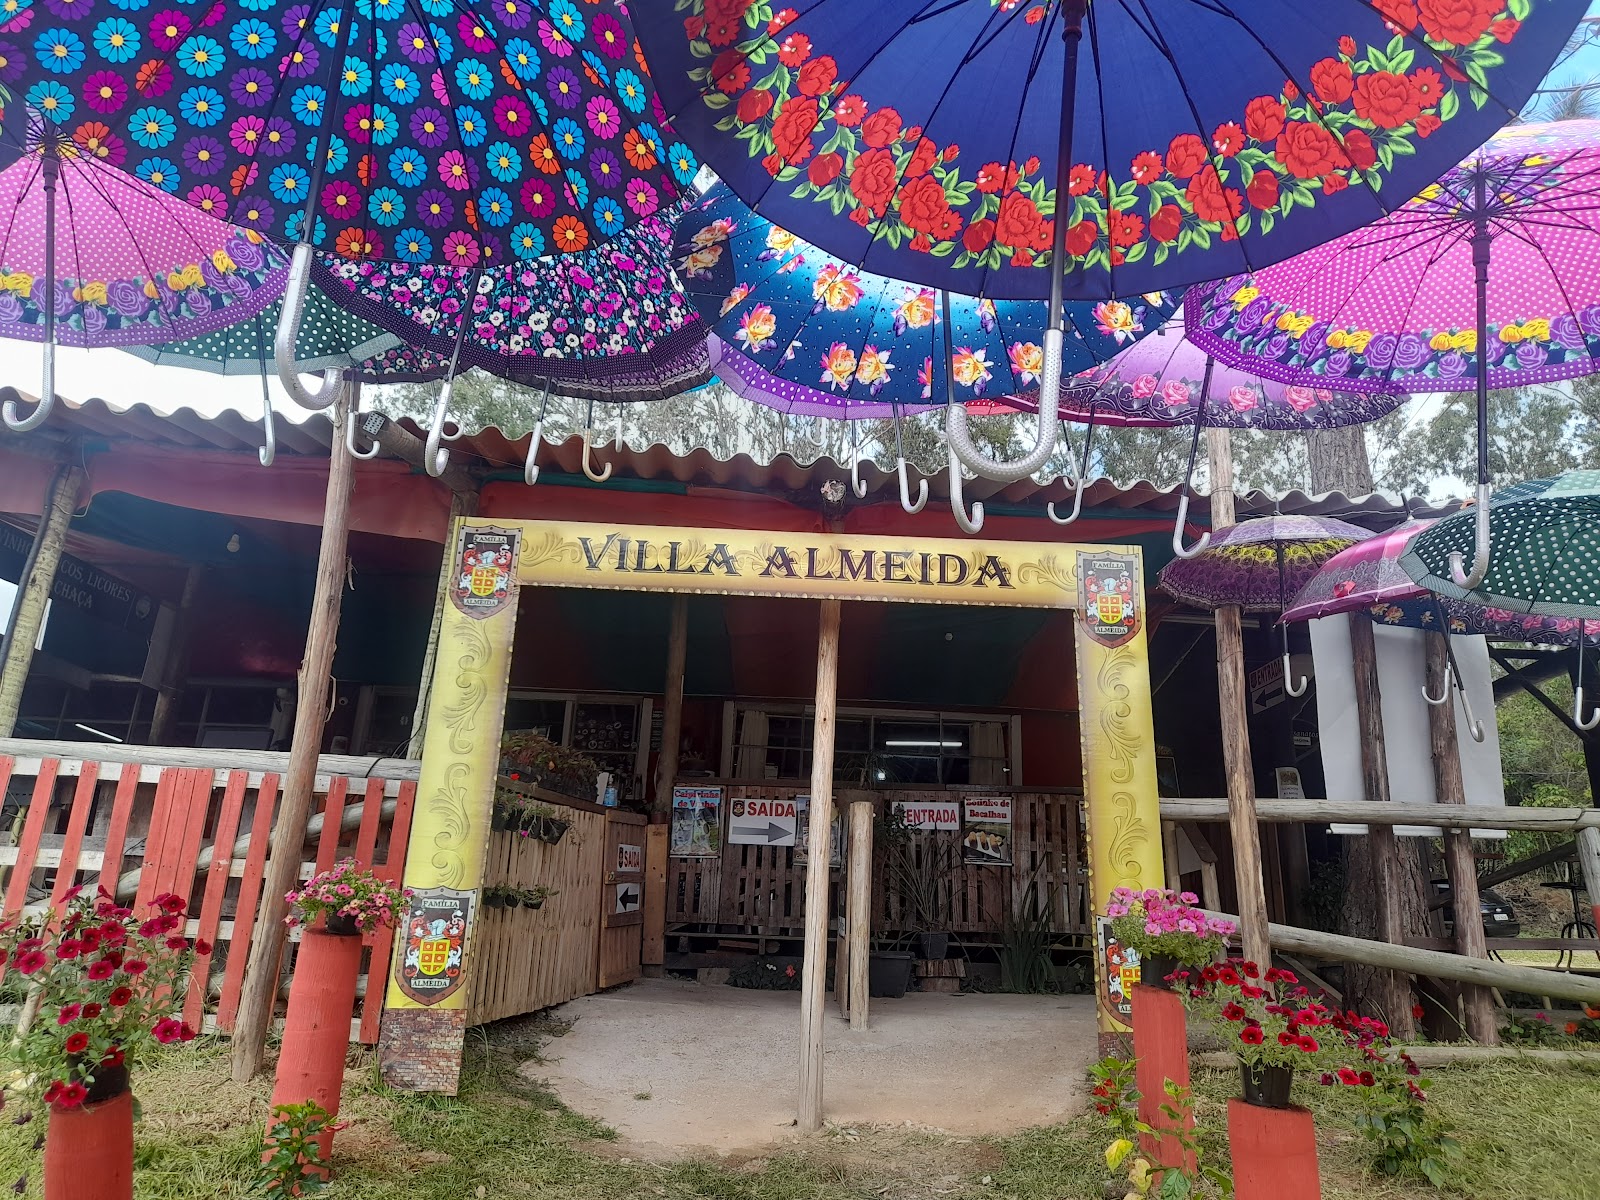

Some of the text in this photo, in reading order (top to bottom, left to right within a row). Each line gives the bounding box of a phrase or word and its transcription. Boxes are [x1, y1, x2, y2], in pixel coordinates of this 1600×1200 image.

[577, 531, 1016, 589] VILLA ALMEIDA
[1093, 561, 1124, 569] FAMÍLIA
[87, 572, 132, 602] LICORES
[464, 598, 497, 607] ALMEIDA
[1096, 626, 1126, 634] ALMEIDA
[689, 800, 715, 808] Vnho
[1000, 799, 1010, 808] de
[748, 800, 796, 817] SAÍDA
[906, 809, 957, 824] ENTRADA
[969, 809, 1007, 819] Bacalhau
[423, 899, 459, 908] FAMÍLIA
